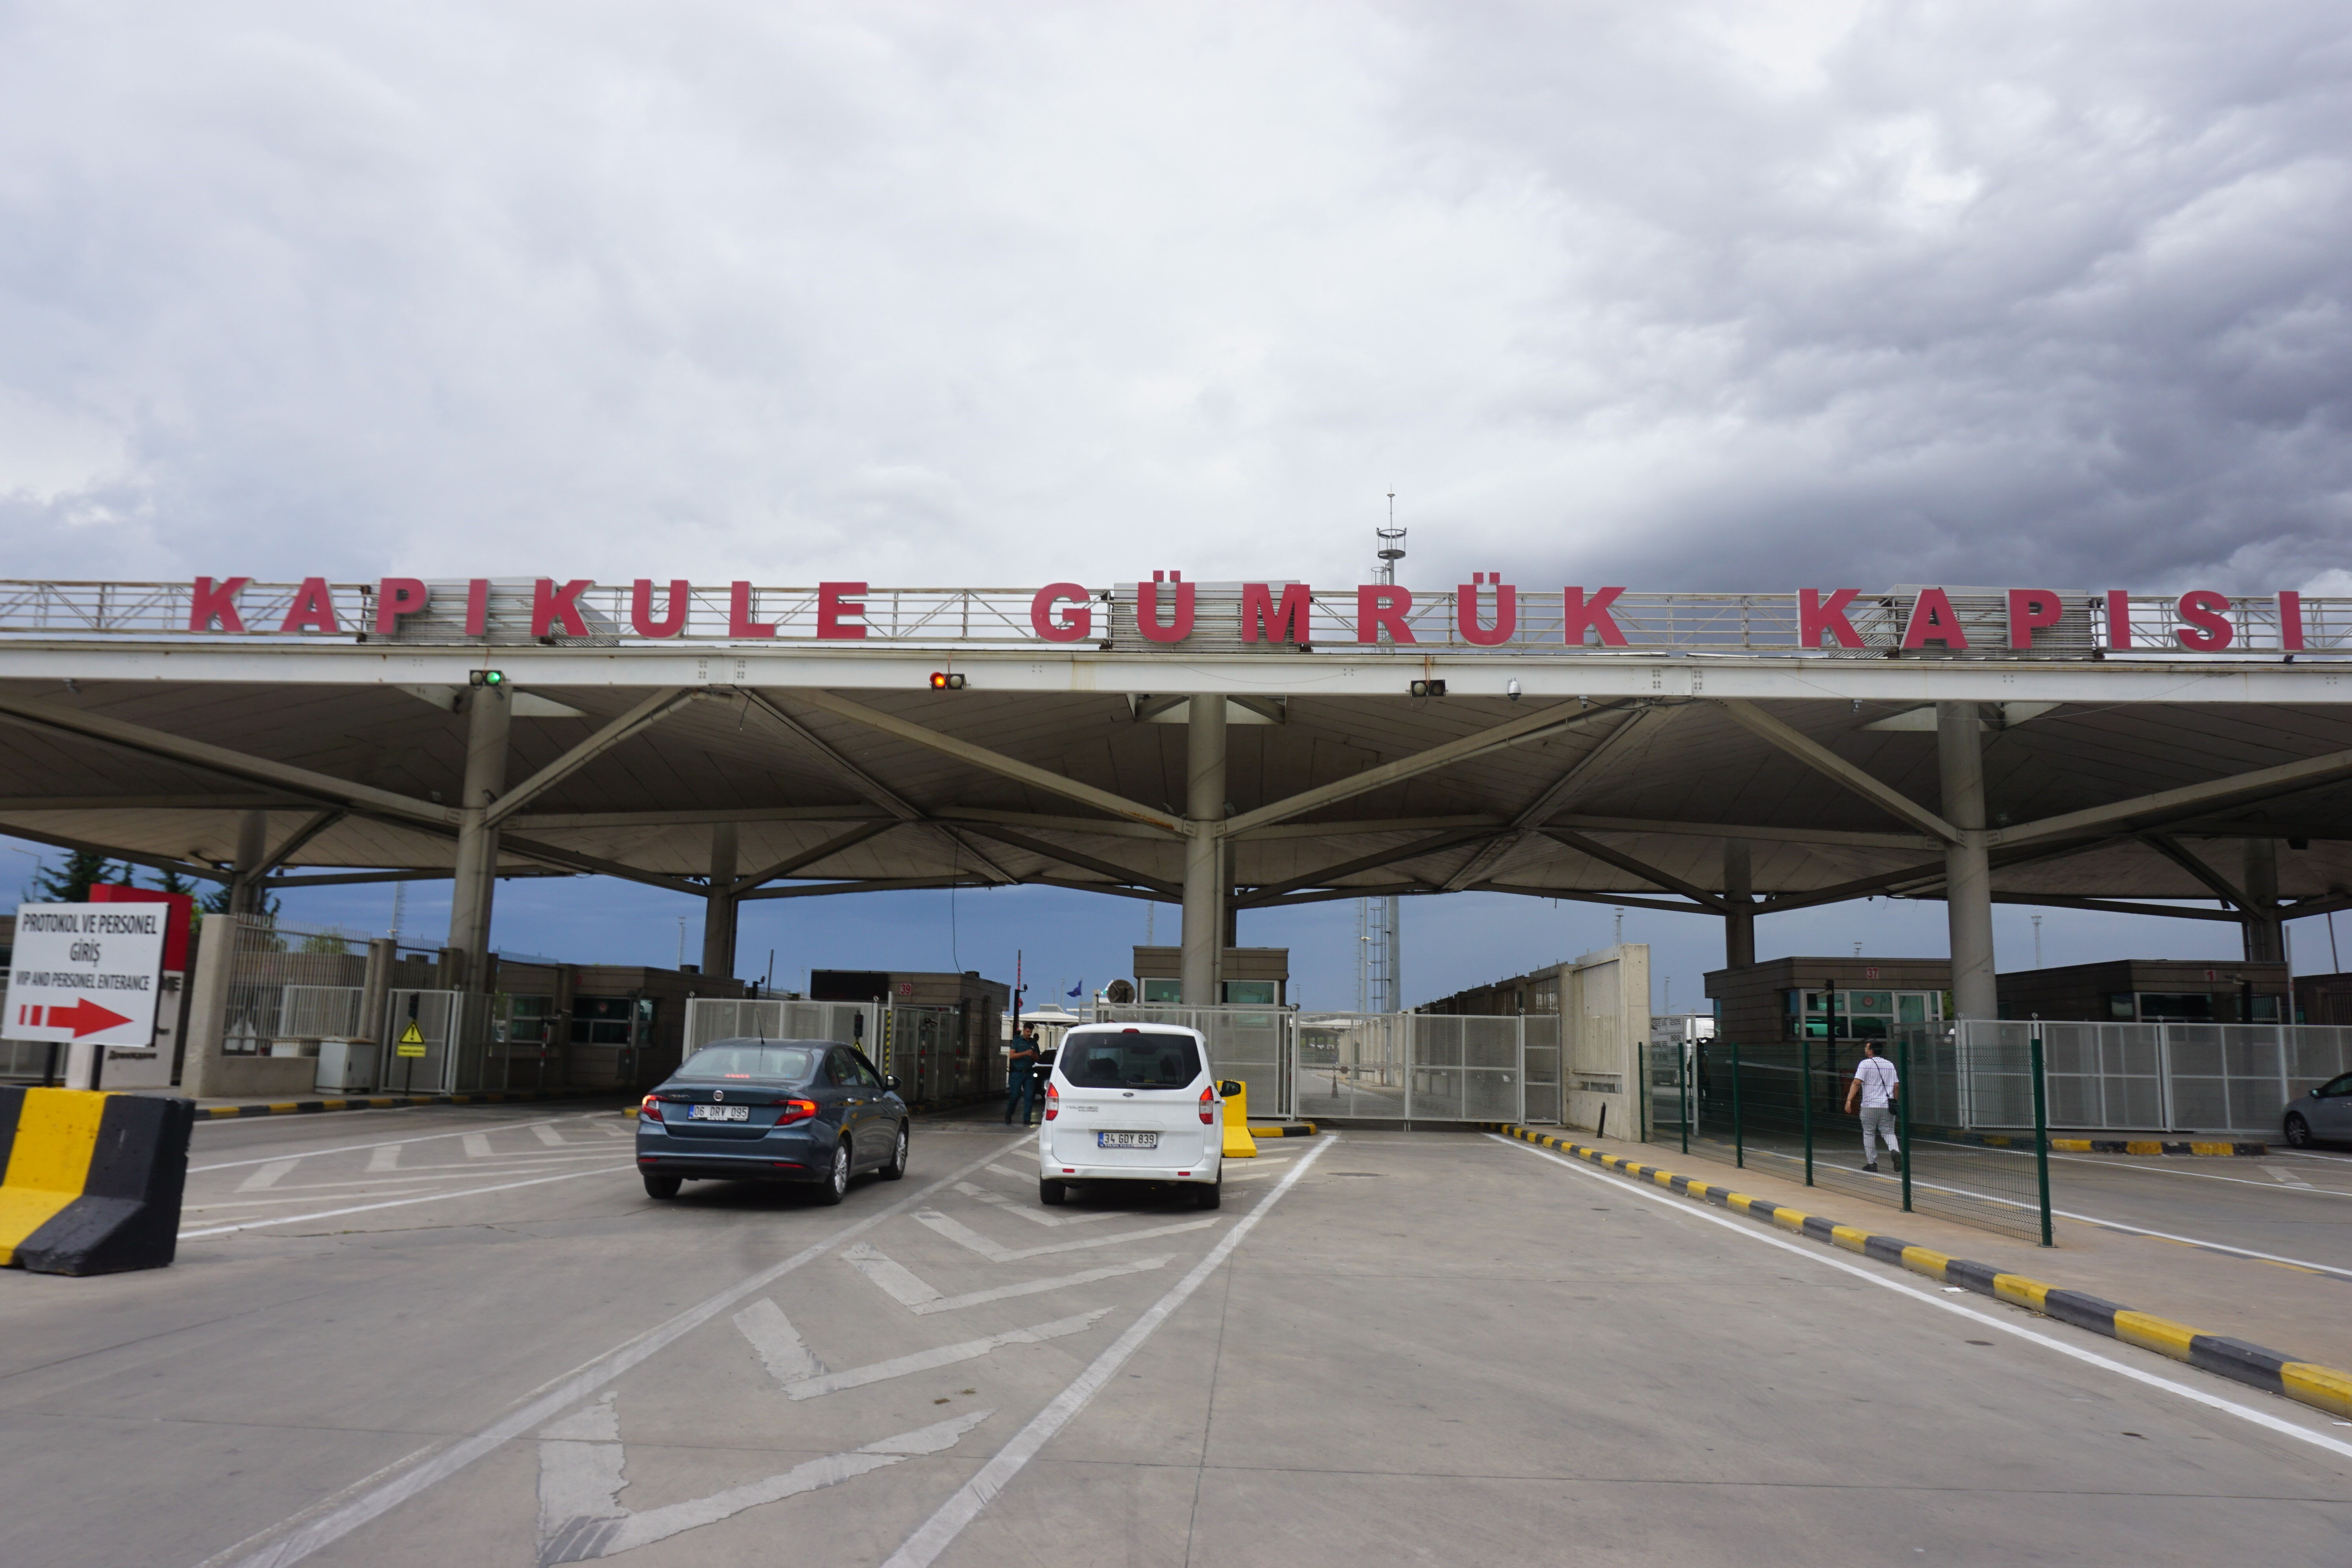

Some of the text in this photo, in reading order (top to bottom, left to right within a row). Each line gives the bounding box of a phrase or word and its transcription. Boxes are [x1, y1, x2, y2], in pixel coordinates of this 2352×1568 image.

[189, 570, 2304, 651] KAPIKULE GÜMRÜK KAPISI
[22, 913, 157, 935] PROTOKOL VE PERSONEL
[69, 938, 102, 967] GİRİŞ
[1867, 968, 1878, 978] 37
[2207, 970, 2214, 981] 1
[16, 971, 31, 986] VIP
[33, 972, 49, 987] AND
[51, 972, 95, 989] PERSONEL
[97, 974, 151, 991] ENTERANCE
[901, 984, 911, 994] 39
[694, 1106, 705, 1116] 06
[731, 1107, 747, 1117] 095
[1104, 1134, 1154, 1144] 34 GDY 839
